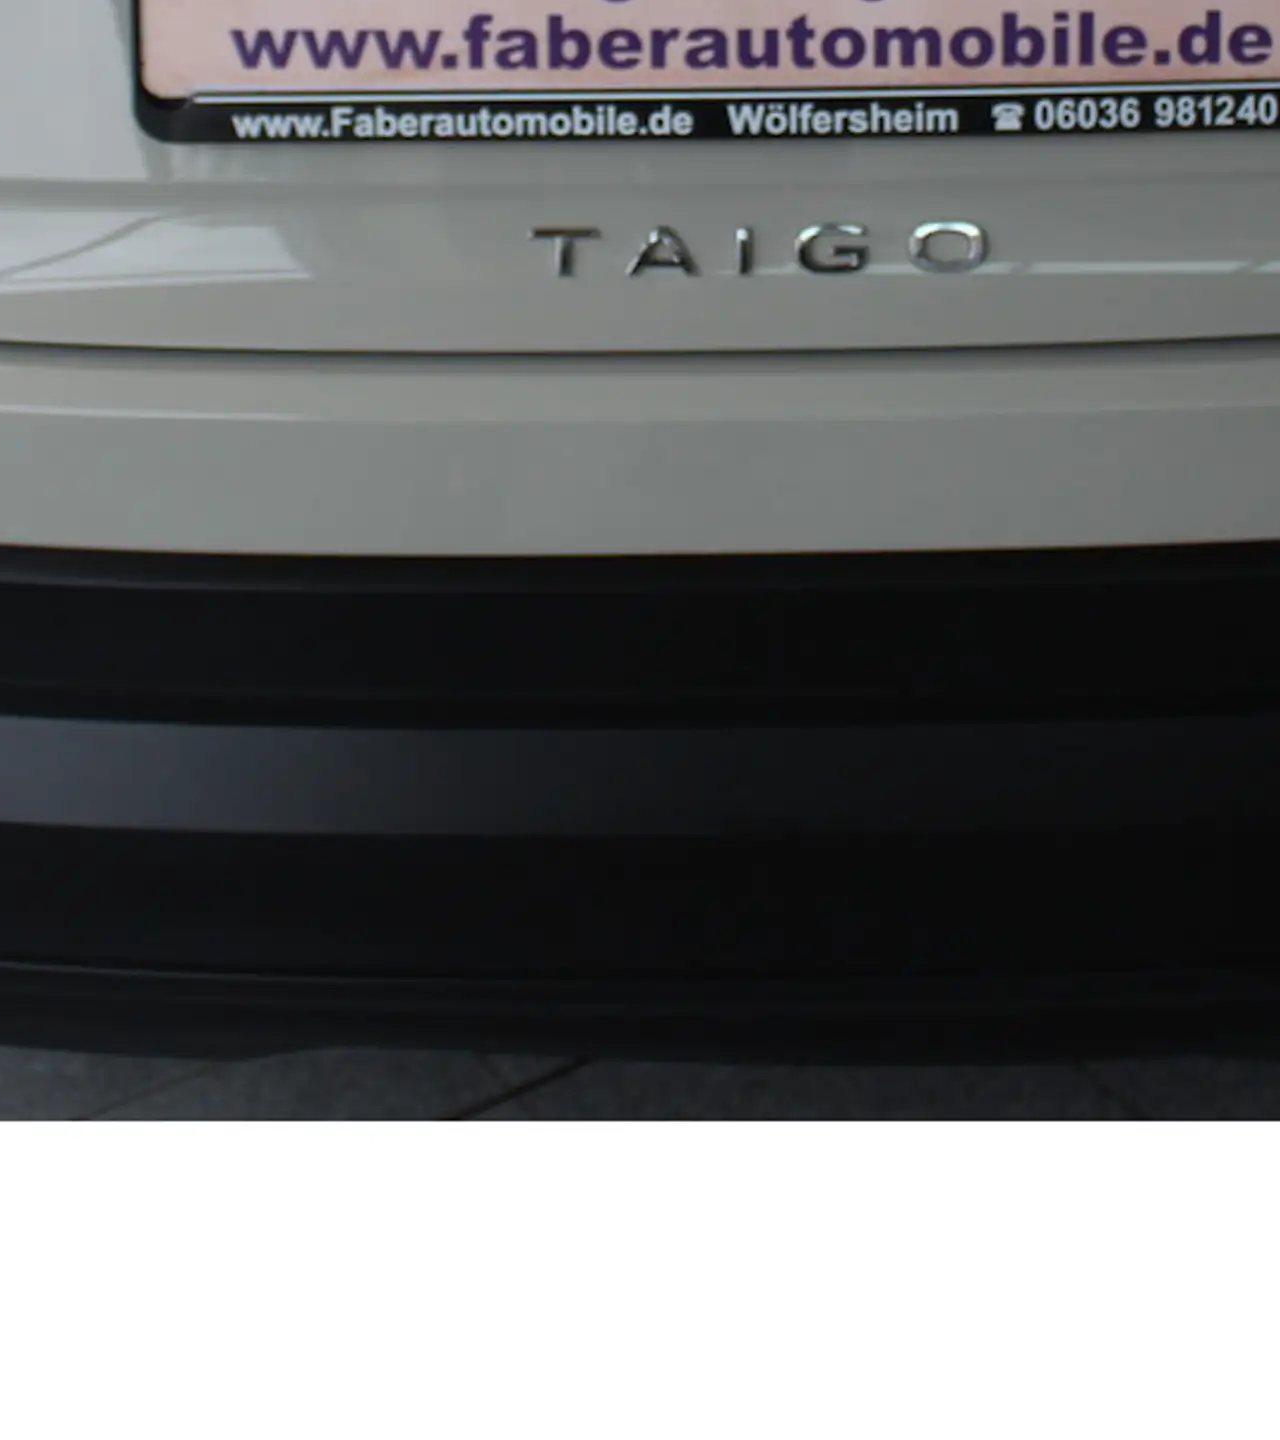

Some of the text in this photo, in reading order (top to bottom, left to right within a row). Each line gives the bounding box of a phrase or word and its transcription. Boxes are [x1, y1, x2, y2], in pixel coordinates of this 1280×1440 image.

[230, 10, 1273, 71] www.faberautomobile.de
[231, 93, 1279, 139] www.Faberautomobile.de Wölfersheim 06036 981240
[528, 220, 990, 278] TAIGO
